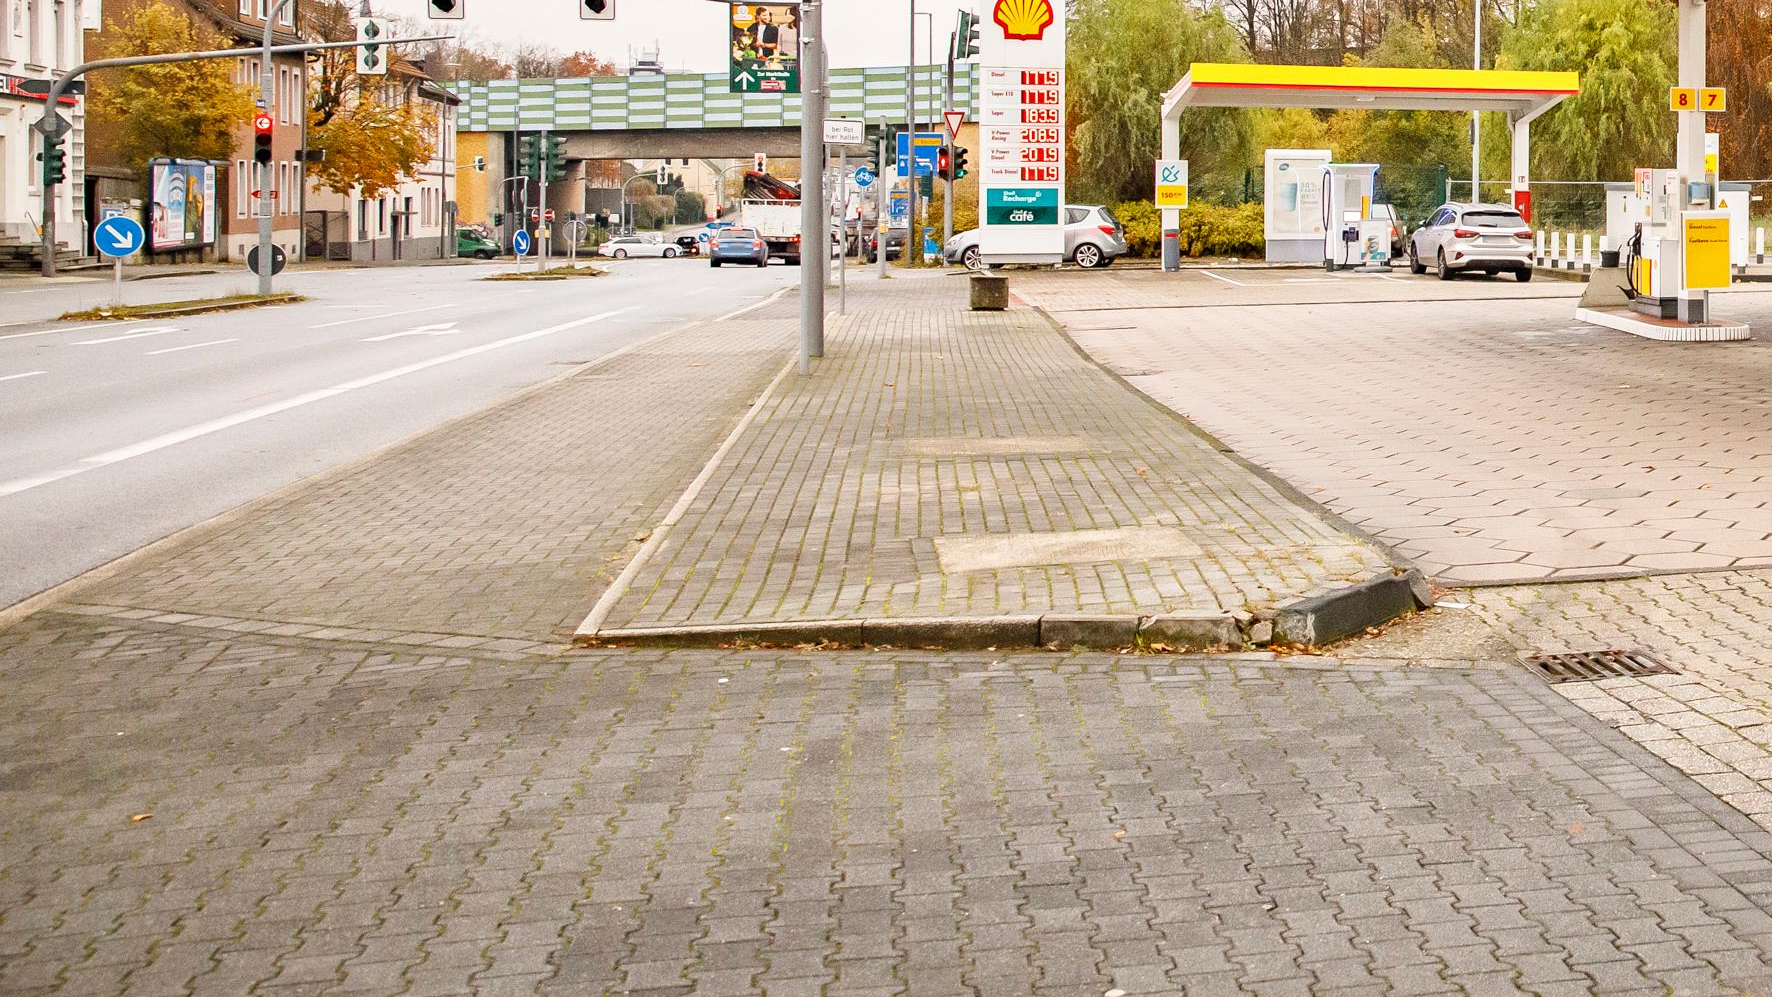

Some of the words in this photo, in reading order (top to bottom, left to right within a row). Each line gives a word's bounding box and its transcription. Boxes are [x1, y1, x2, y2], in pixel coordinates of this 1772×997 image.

[1679, 93, 1688, 106] 8
[1708, 94, 1718, 106] 7
[1002, 194, 1037, 203] Recharge
[1009, 210, 1034, 222] café
